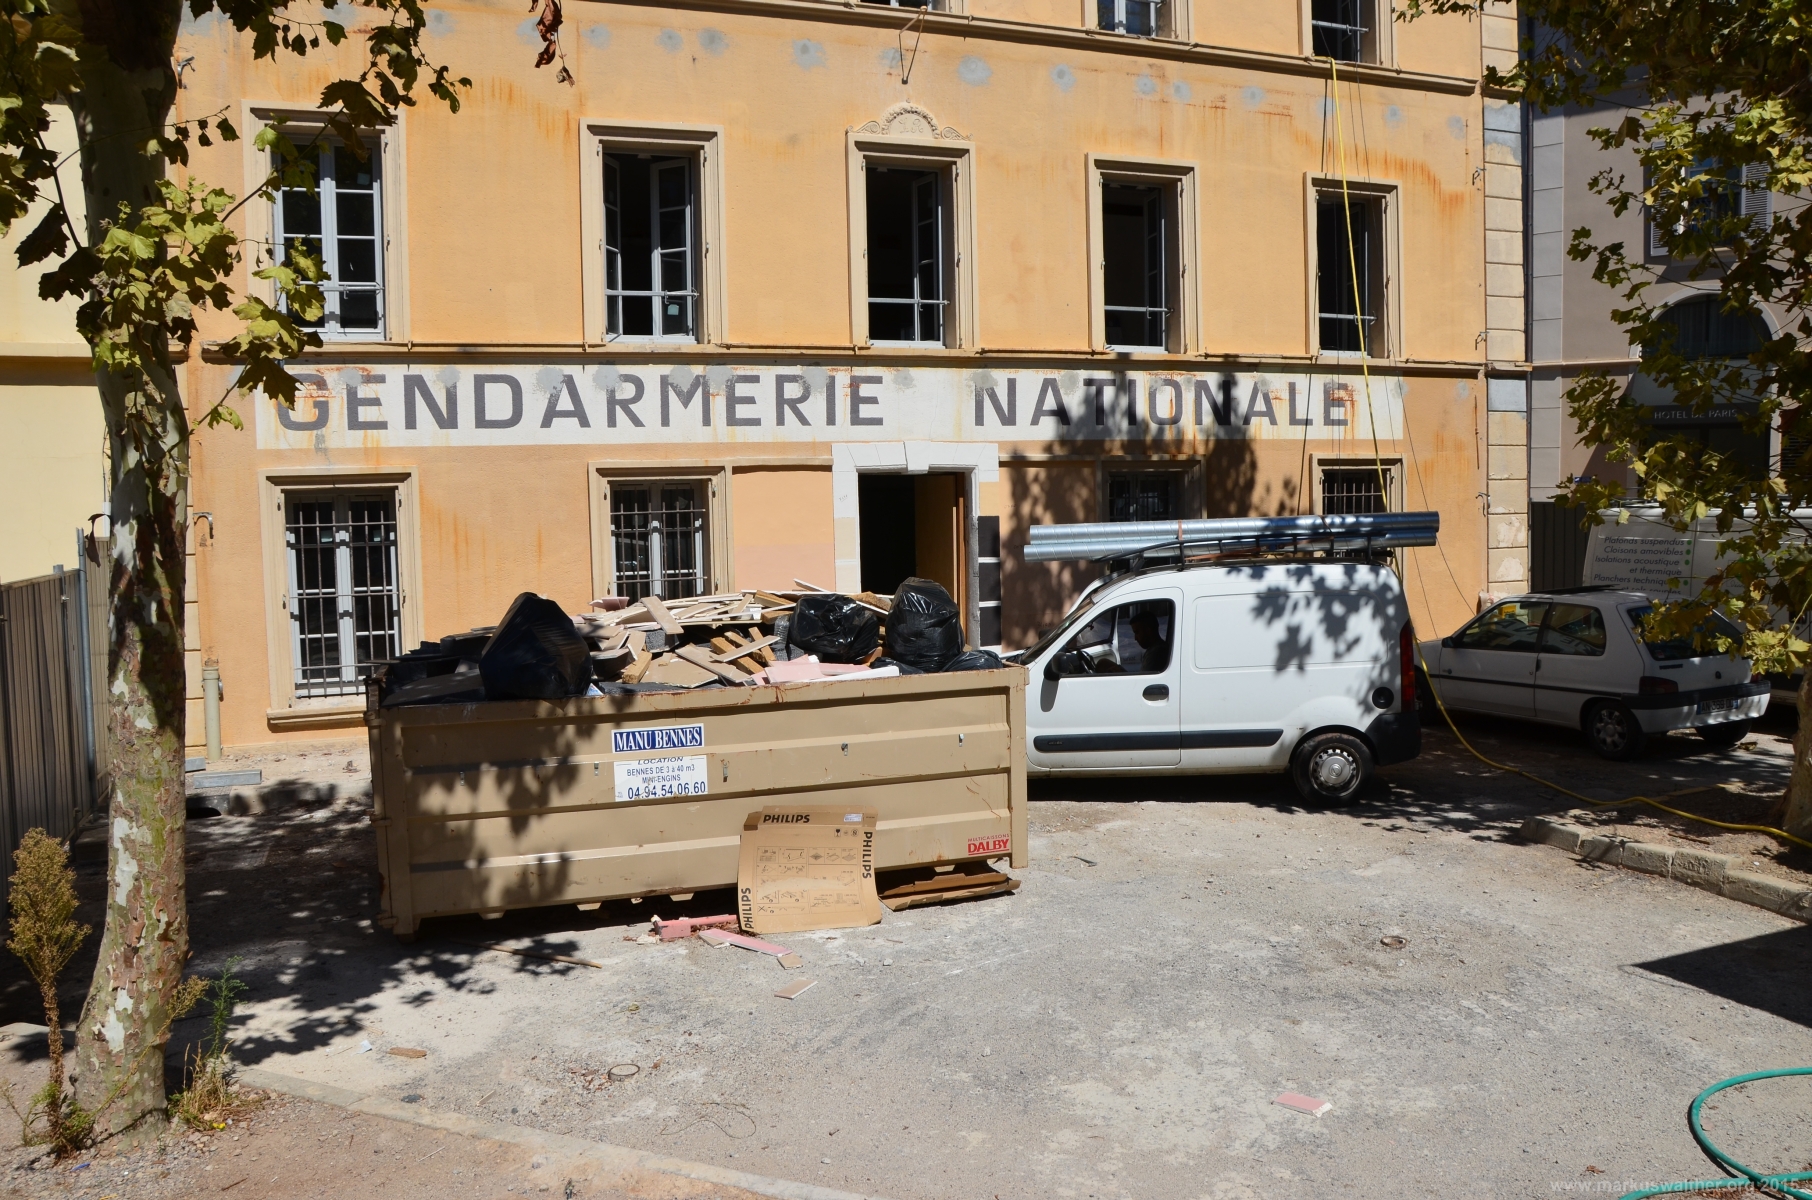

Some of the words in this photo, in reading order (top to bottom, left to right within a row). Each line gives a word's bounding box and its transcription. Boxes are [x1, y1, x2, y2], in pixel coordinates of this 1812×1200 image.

[278, 372, 885, 432] GENDARMERIE
[974, 375, 1350, 427] NATIONALE
[1654, 410, 1688, 420] HOTEL
[1708, 408, 1738, 418] PARIS
[1604, 536, 1638, 545] Plafonds
[1640, 538, 1684, 546] suspendus
[1604, 545, 1637, 554] Cloisons
[1640, 547, 1683, 555] amovibles
[1595, 555, 1631, 564] Isolations
[1633, 557, 1680, 567] acoustique
[1640, 566, 1682, 577] thermique
[1594, 573, 1631, 583] Planchers
[615, 730, 652, 751] MANU
[654, 727, 701, 749] BENNES
[637, 756, 684, 765] LOCATION
[626, 766, 654, 776] BENNES
[655, 765, 665, 774] DE
[665, 765, 670, 773] 3
[676, 764, 684, 772] 40
[685, 763, 696, 772] m3
[641, 773, 681, 784] MINI-ENGINS
[627, 780, 706, 799] 04.94.5406.60
[762, 813, 811, 824] PHILIPS
[967, 833, 1010, 843] MULTICAISSONS
[967, 838, 1010, 853] DALBY
[862, 831, 873, 879] PHILIPS
[740, 887, 753, 930] PHILIPS
